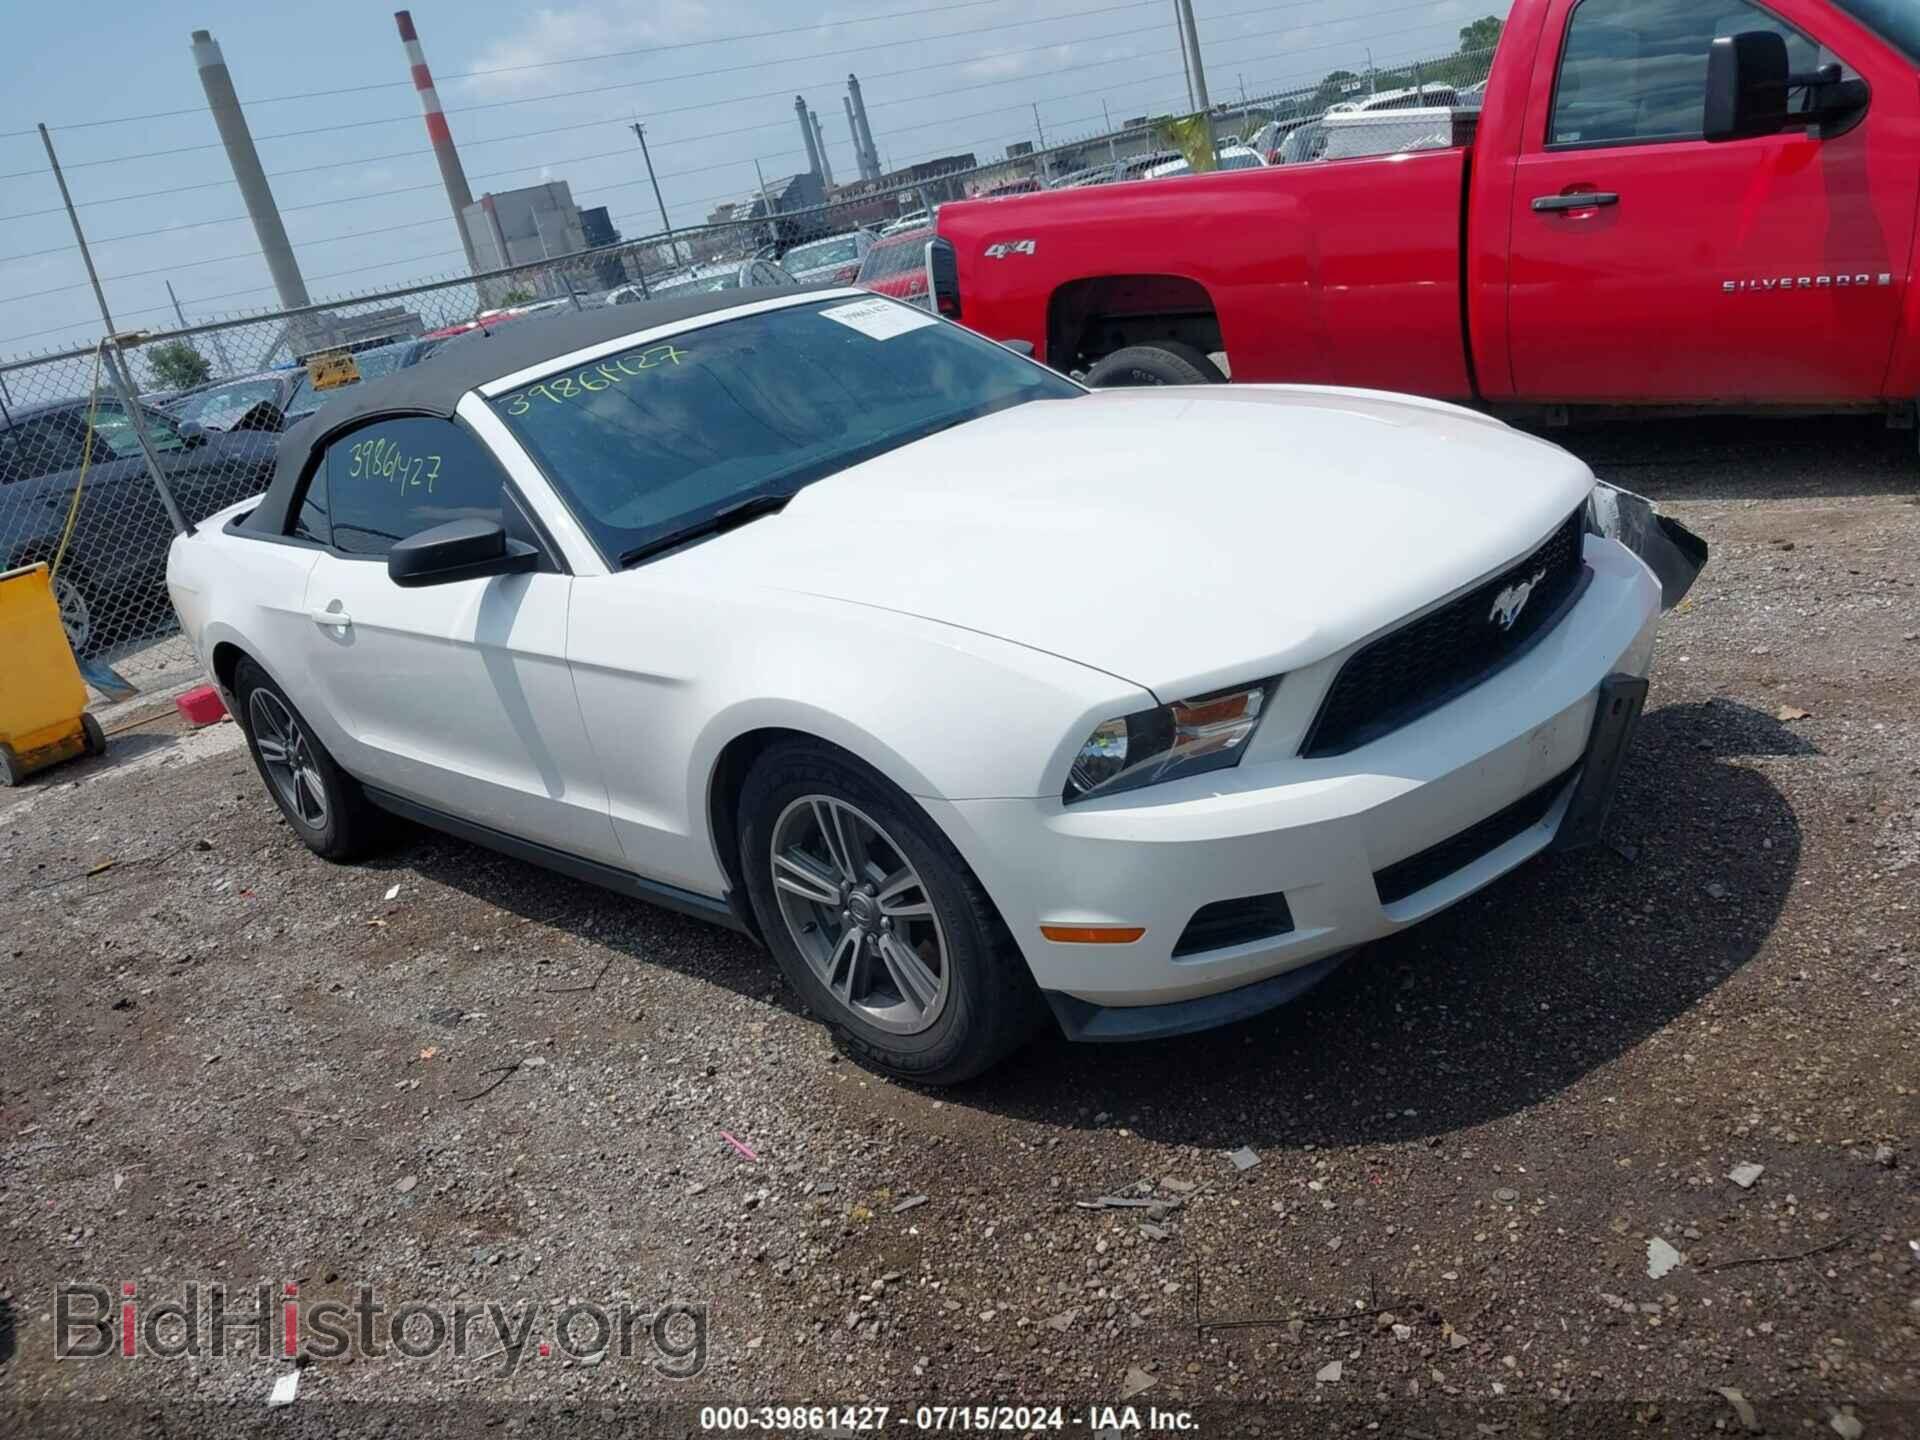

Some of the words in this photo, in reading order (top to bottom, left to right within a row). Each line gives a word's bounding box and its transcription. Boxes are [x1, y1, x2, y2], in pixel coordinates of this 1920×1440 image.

[1722, 273, 1870, 292] SILVERADO
[498, 345, 689, 416] 39861427
[349, 438, 441, 497] 39861427
